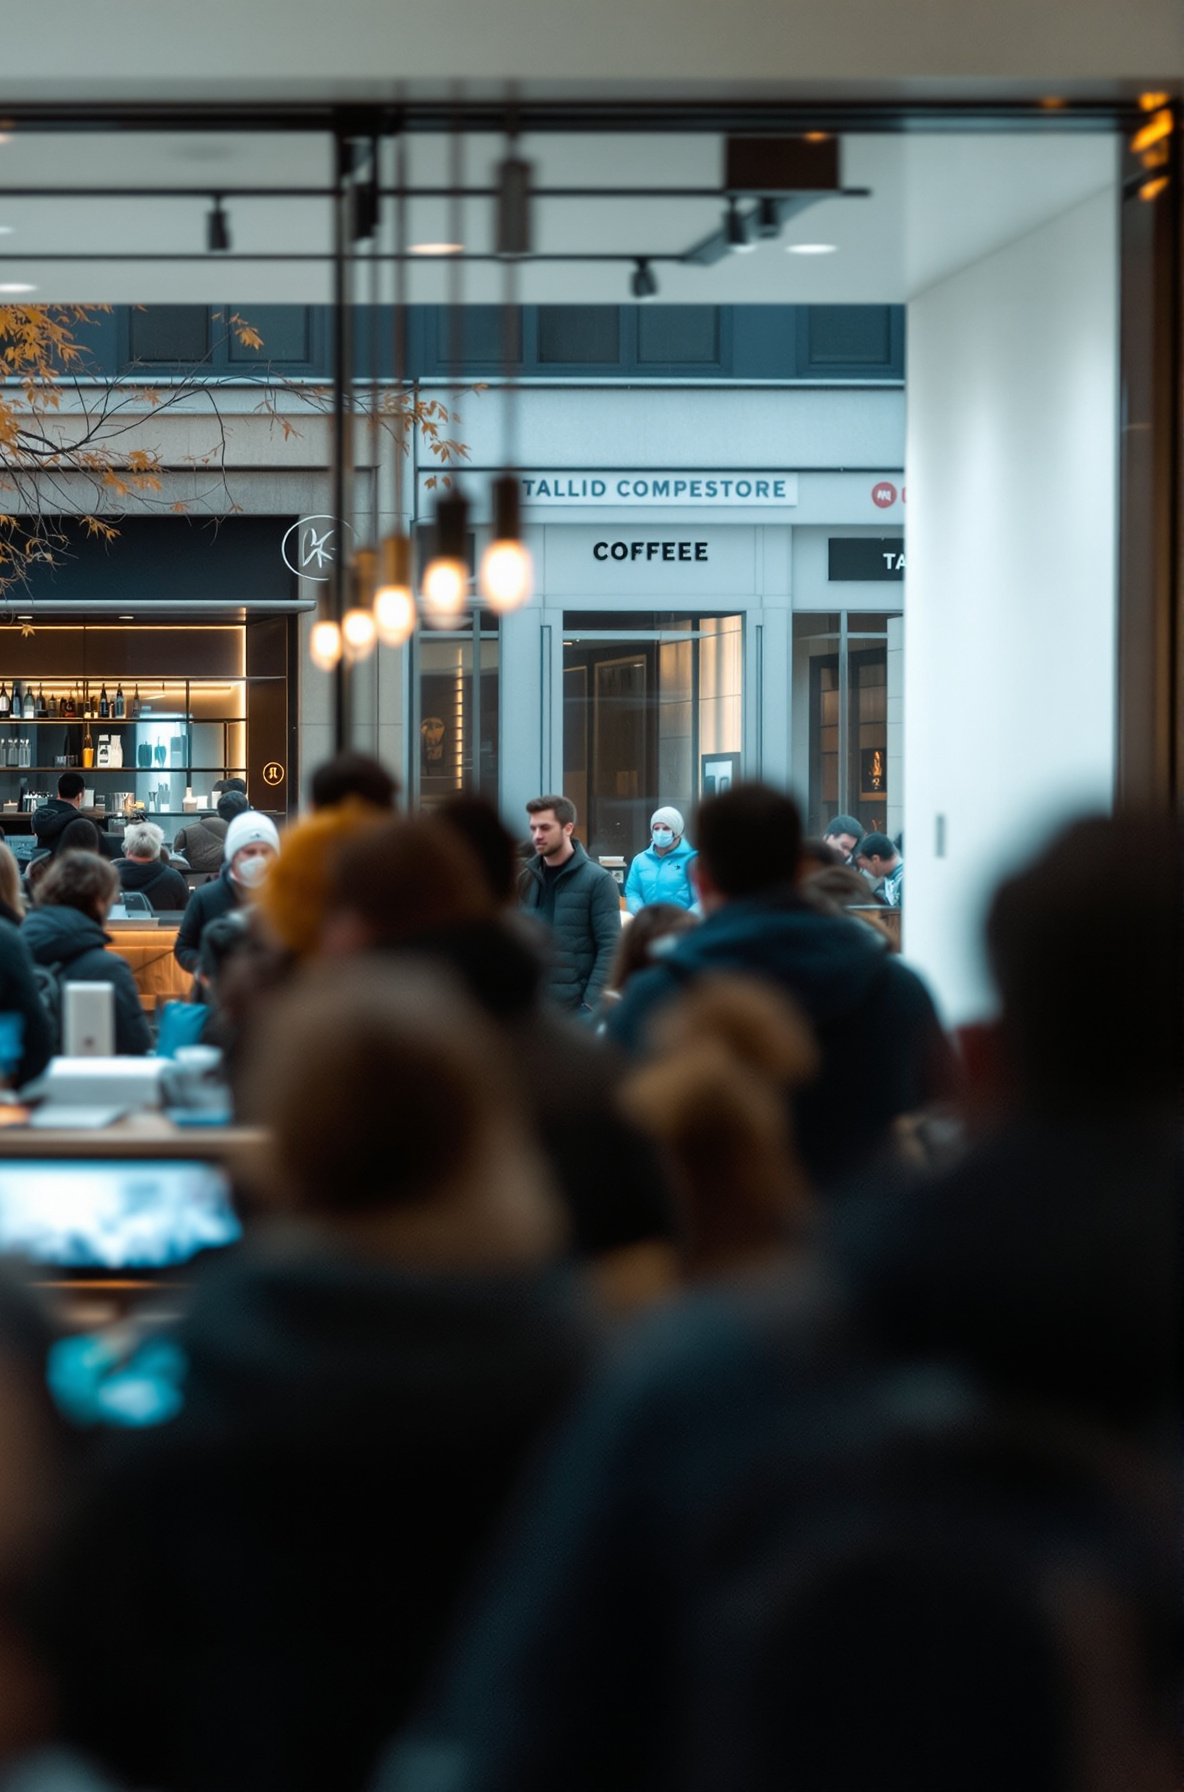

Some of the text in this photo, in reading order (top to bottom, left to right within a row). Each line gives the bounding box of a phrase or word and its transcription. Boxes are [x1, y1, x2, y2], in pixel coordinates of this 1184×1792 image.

[522, 479, 787, 498] TALLID COMPESTORE
[592, 541, 709, 561] COFFEEE
